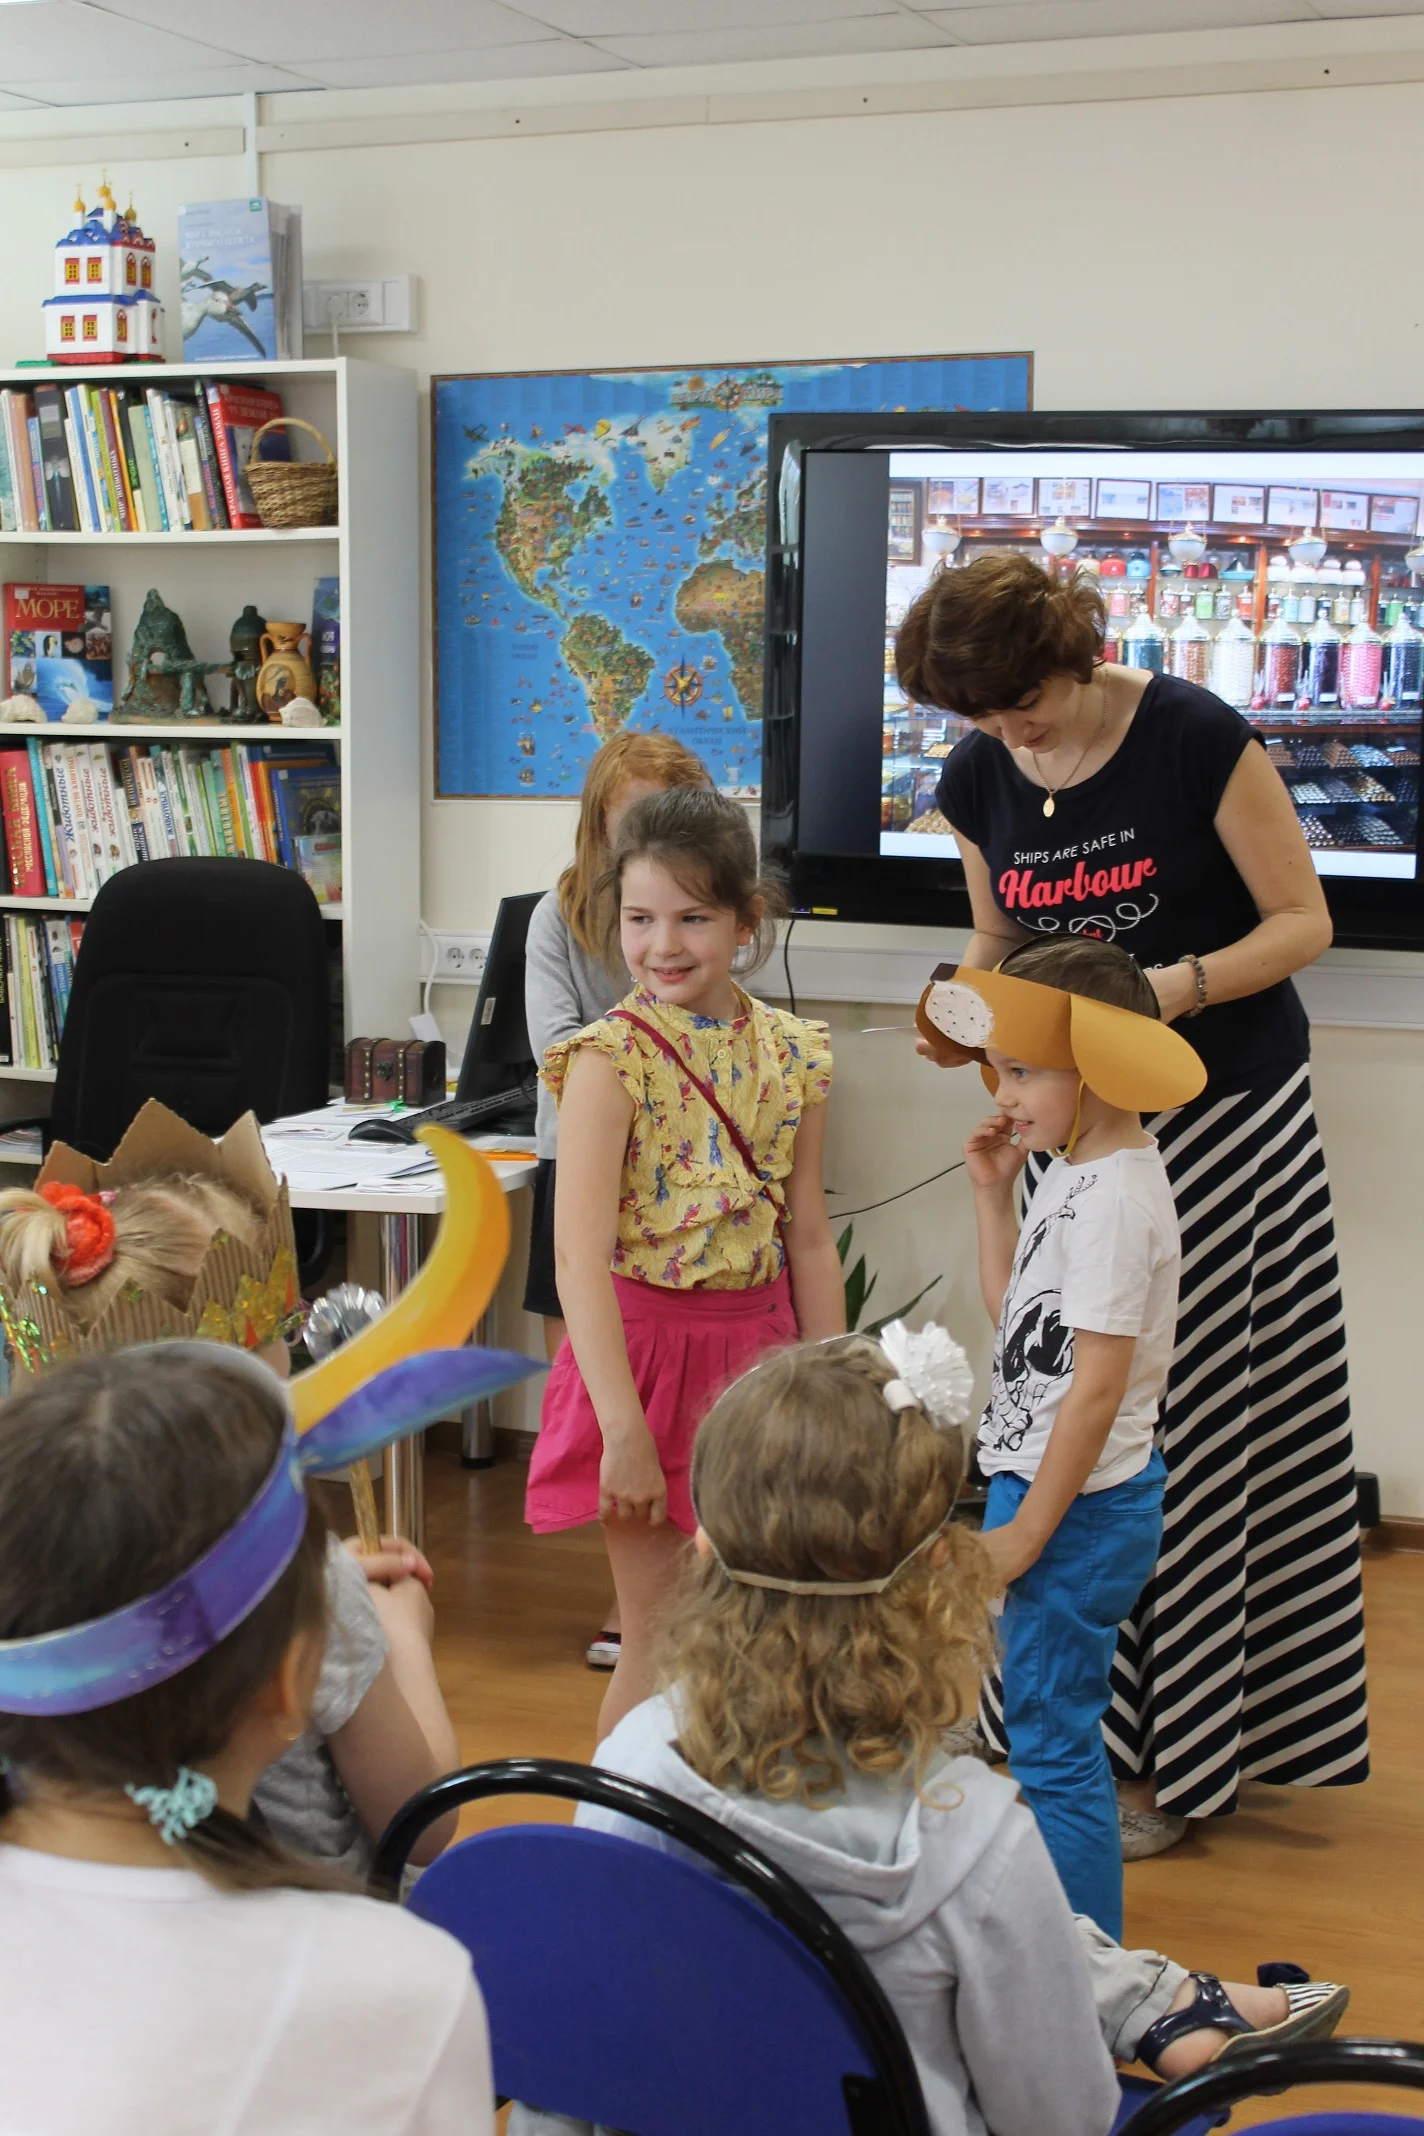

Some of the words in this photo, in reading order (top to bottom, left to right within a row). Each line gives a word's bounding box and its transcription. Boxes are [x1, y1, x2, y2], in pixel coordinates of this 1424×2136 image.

[211, 407, 224, 440] ЗЕМЛИ
[217, 441, 230, 472] КНИГА
[222, 473, 237, 516] КРАСНАЯ
[15, 598, 80, 618] МОРЕ
[56, 767, 75, 842] Животные
[82, 768, 99, 833] животные
[100, 767, 116, 838] животные
[161, 790, 173, 834] ЖИВОТНЫХ
[1013, 852, 1049, 865] SHIPS
[1052, 846, 1078, 861] ARE
[1082, 834, 1116, 854] SAFE
[1120, 828, 1135, 843] IN
[998, 858, 1157, 909] Harbour
